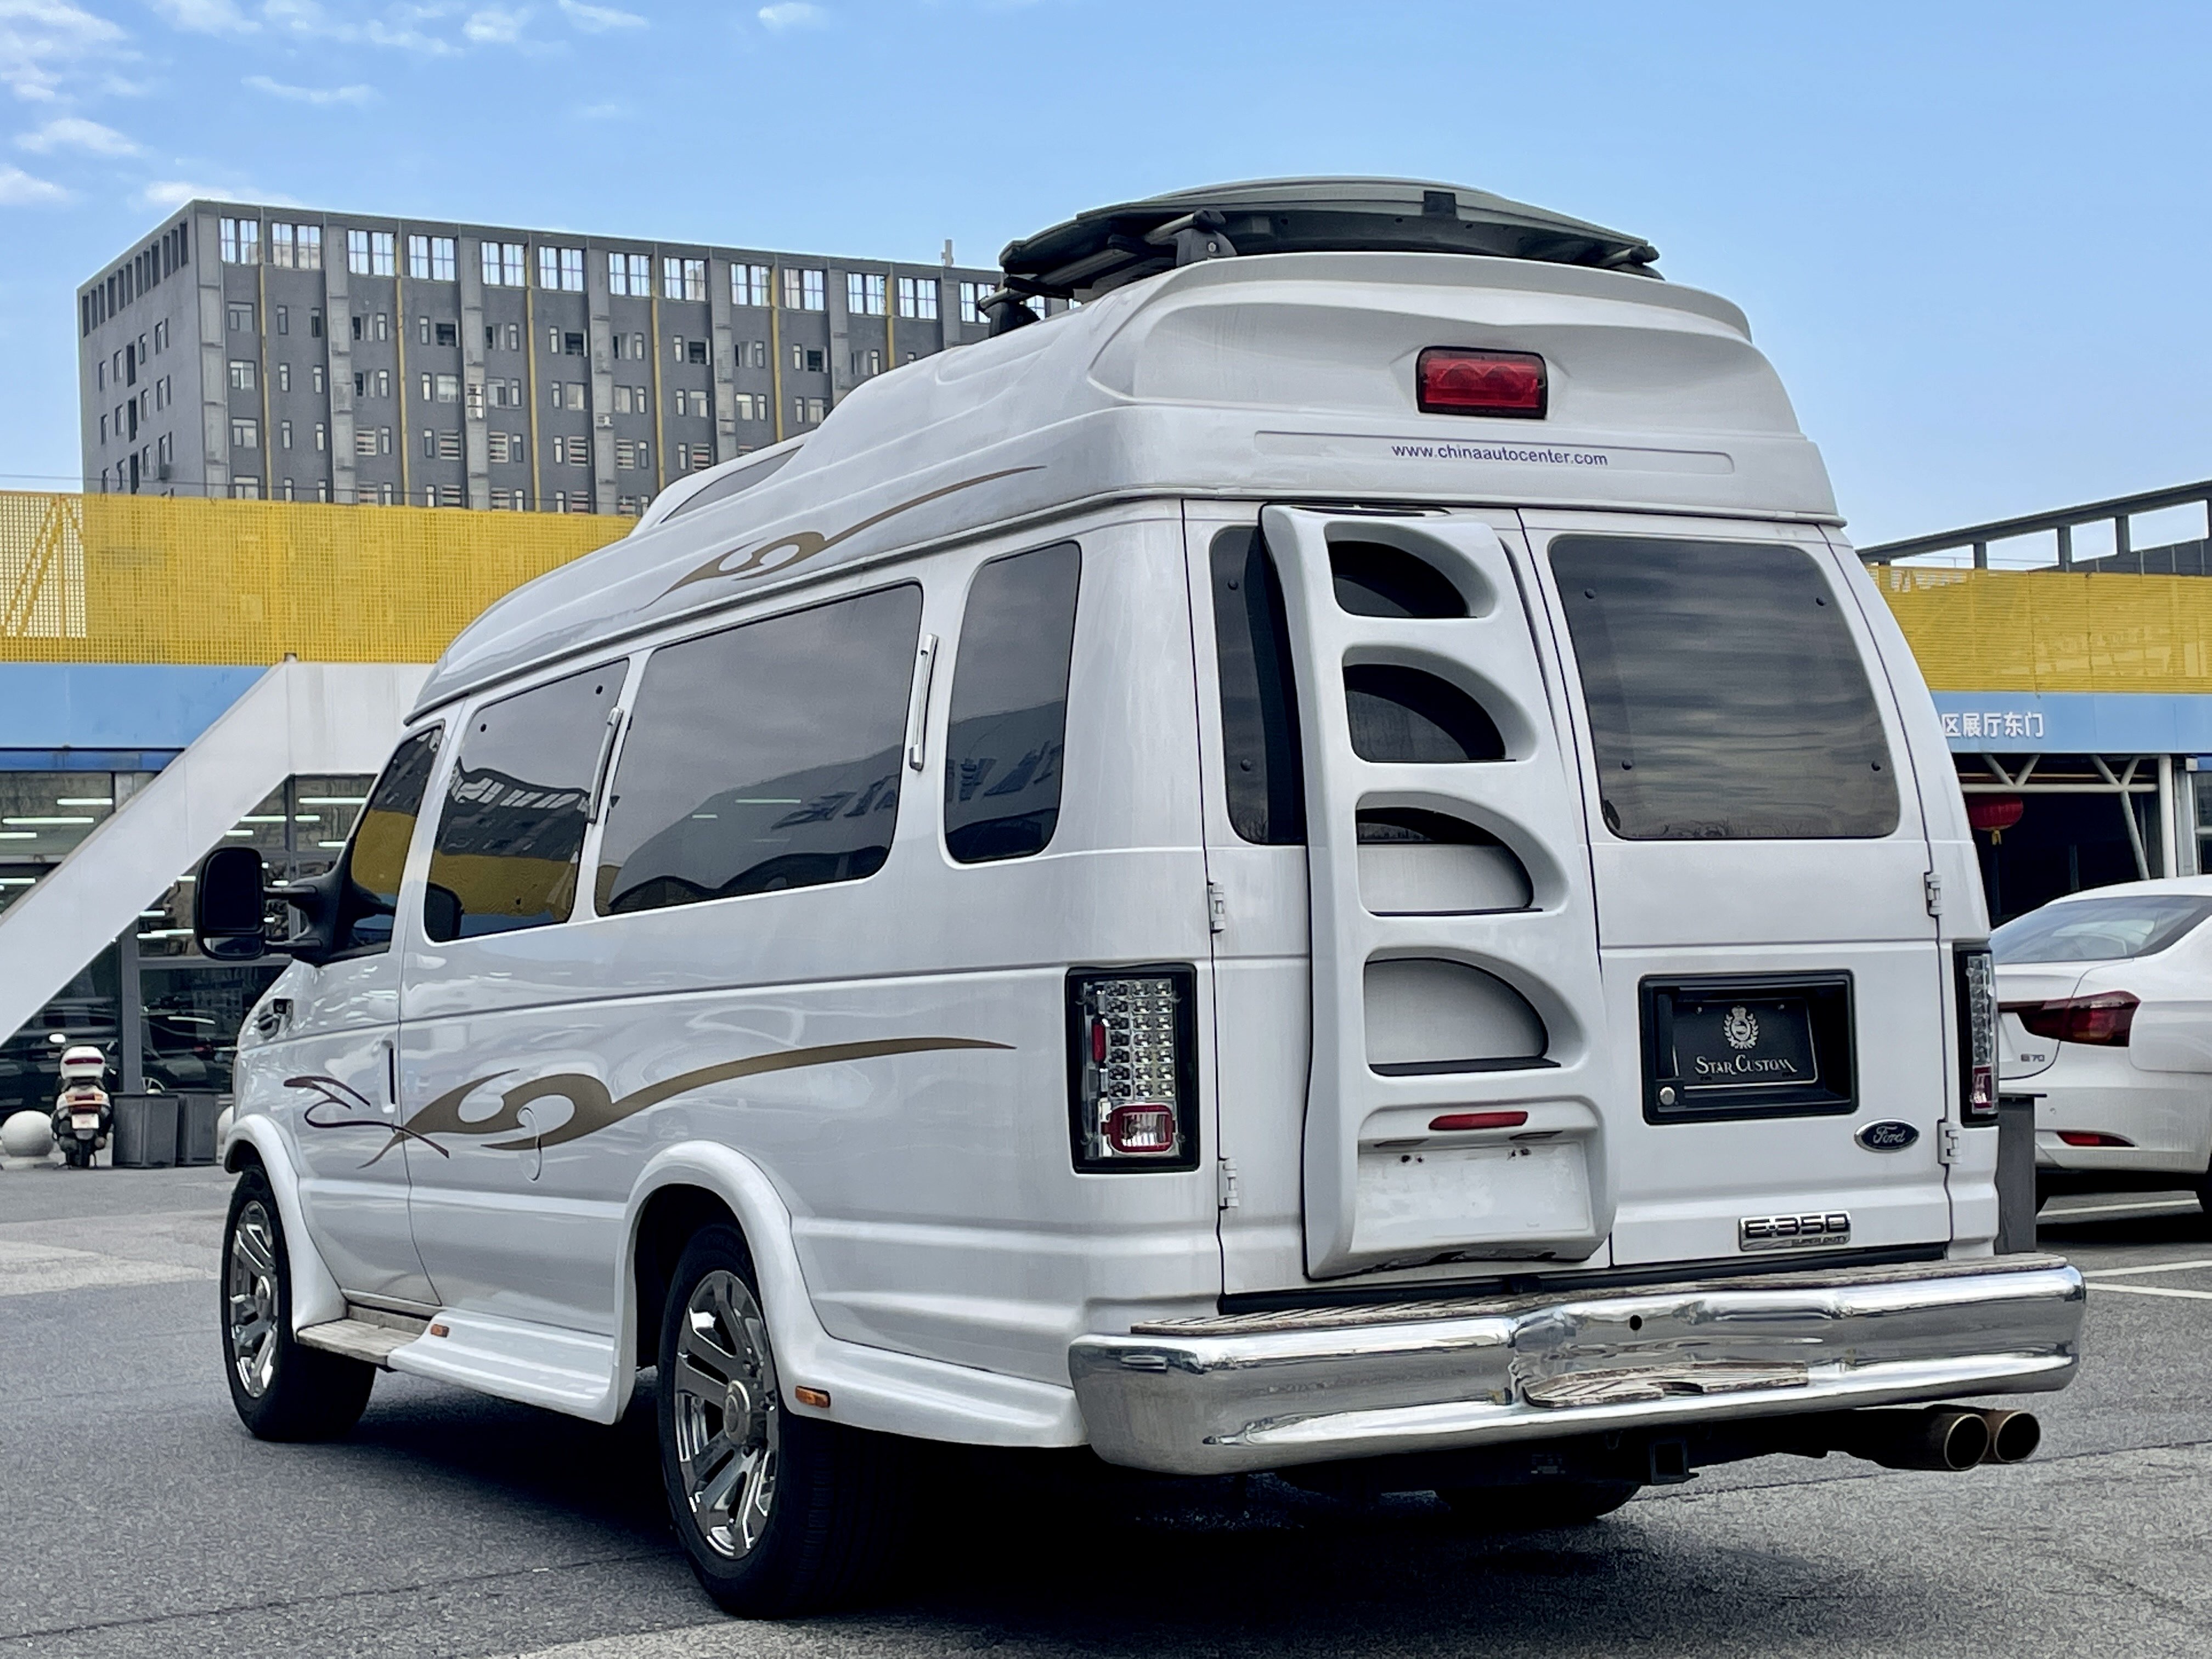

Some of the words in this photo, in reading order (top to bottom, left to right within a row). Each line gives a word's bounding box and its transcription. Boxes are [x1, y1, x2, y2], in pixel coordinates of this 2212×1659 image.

[1391, 444, 1608, 466] www.chinaautocenter.com
[1940, 711, 2044, 737] 区展厅东门
[1872, 1125, 1906, 1144] Ford
